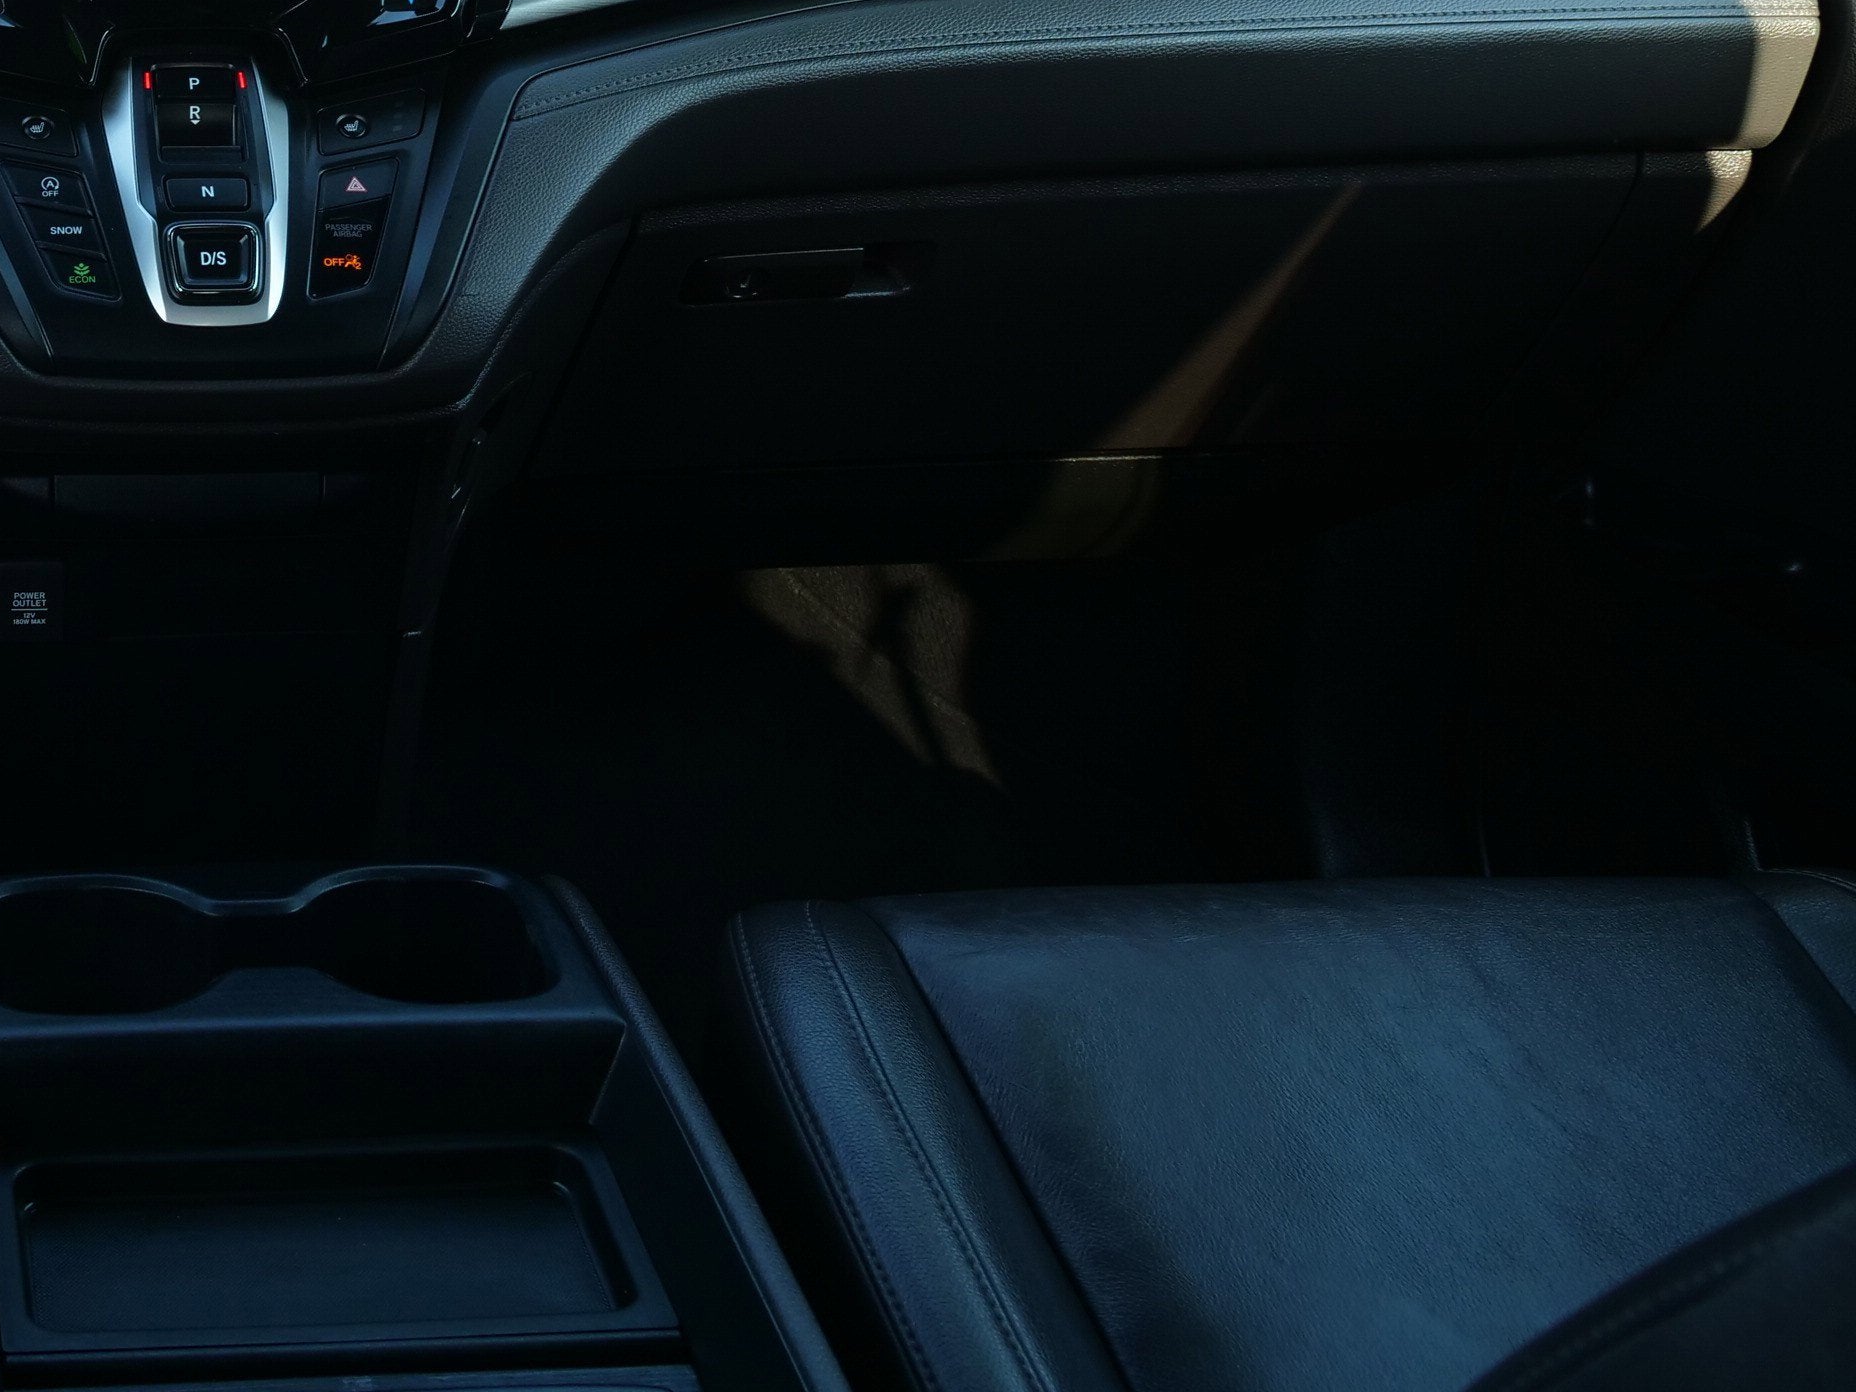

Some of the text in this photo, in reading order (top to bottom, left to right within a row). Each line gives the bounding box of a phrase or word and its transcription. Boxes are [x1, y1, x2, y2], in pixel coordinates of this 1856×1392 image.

[188, 78, 200, 90] P
[189, 106, 200, 120] R
[201, 186, 215, 198] N
[50, 226, 83, 235] SNOW
[333, 230, 363, 238] AIRBAG
[200, 252, 227, 266] D/S
[324, 258, 344, 267] OFF
[68, 276, 96, 284] ECON
[14, 592, 46, 600] POWER
